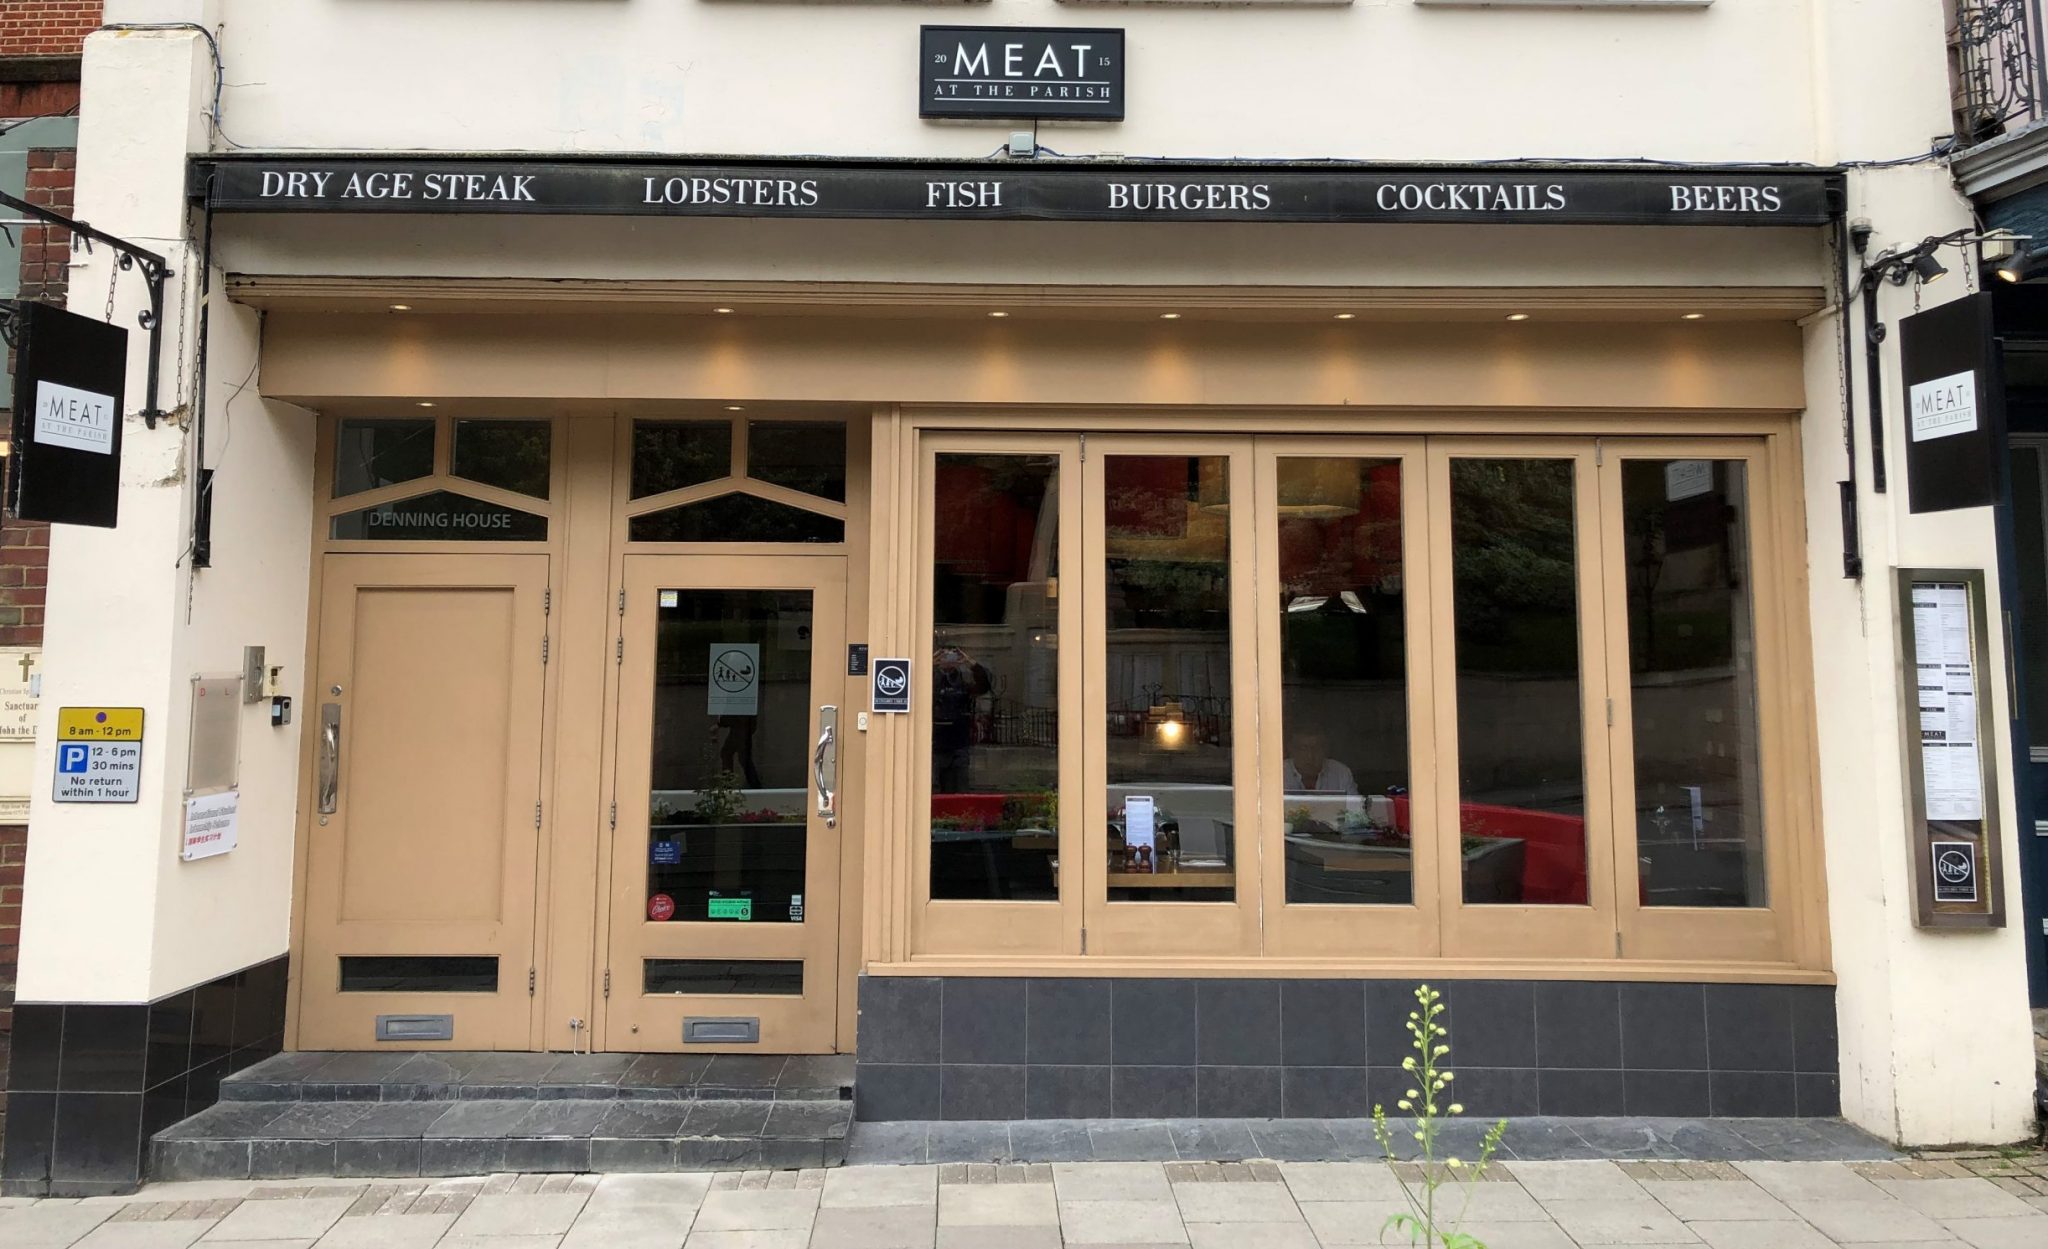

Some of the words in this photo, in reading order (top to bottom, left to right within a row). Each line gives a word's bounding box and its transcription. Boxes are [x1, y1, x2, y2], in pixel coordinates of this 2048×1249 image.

[934, 54, 947, 64] 20
[953, 41, 1092, 78] MEAT
[1098, 57, 1111, 66] 15
[934, 84, 958, 95] AT
[974, 85, 1014, 96] THE
[1030, 86, 1111, 98] PARISH
[260, 171, 333, 198] DRY
[340, 172, 413, 199] AGE
[423, 173, 537, 202] STEAK
[643, 177, 819, 206] LOBSTERS
[925, 182, 1003, 208] FISH
[1107, 183, 1271, 210] BURGERS
[1376, 183, 1566, 211] COCKTAILS
[1669, 185, 1781, 212] BEERS
[1921, 384, 1964, 415] MEAT
[49, 395, 102, 426] MEAT
[369, 512, 448, 527] DENNING
[453, 513, 511, 528] HOUSE
[4, 701, 39, 711] Sanctuar
[18, 713, 27, 723] of
[18, 725, 30, 735] the
[69, 726, 76, 735] 8
[102, 726, 113, 736] 12
[115, 729, 131, 737] pm
[92, 747, 103, 756] 12
[111, 747, 118, 756] 6
[120, 750, 136, 758] pm
[66, 748, 84, 771] P
[92, 761, 107, 770] 30
[109, 761, 134, 770] mins
[70, 776, 86, 785] No
[89, 777, 122, 786] return
[61, 787, 94, 797] within
[97, 788, 102, 797] 1
[105, 788, 130, 797] hour
